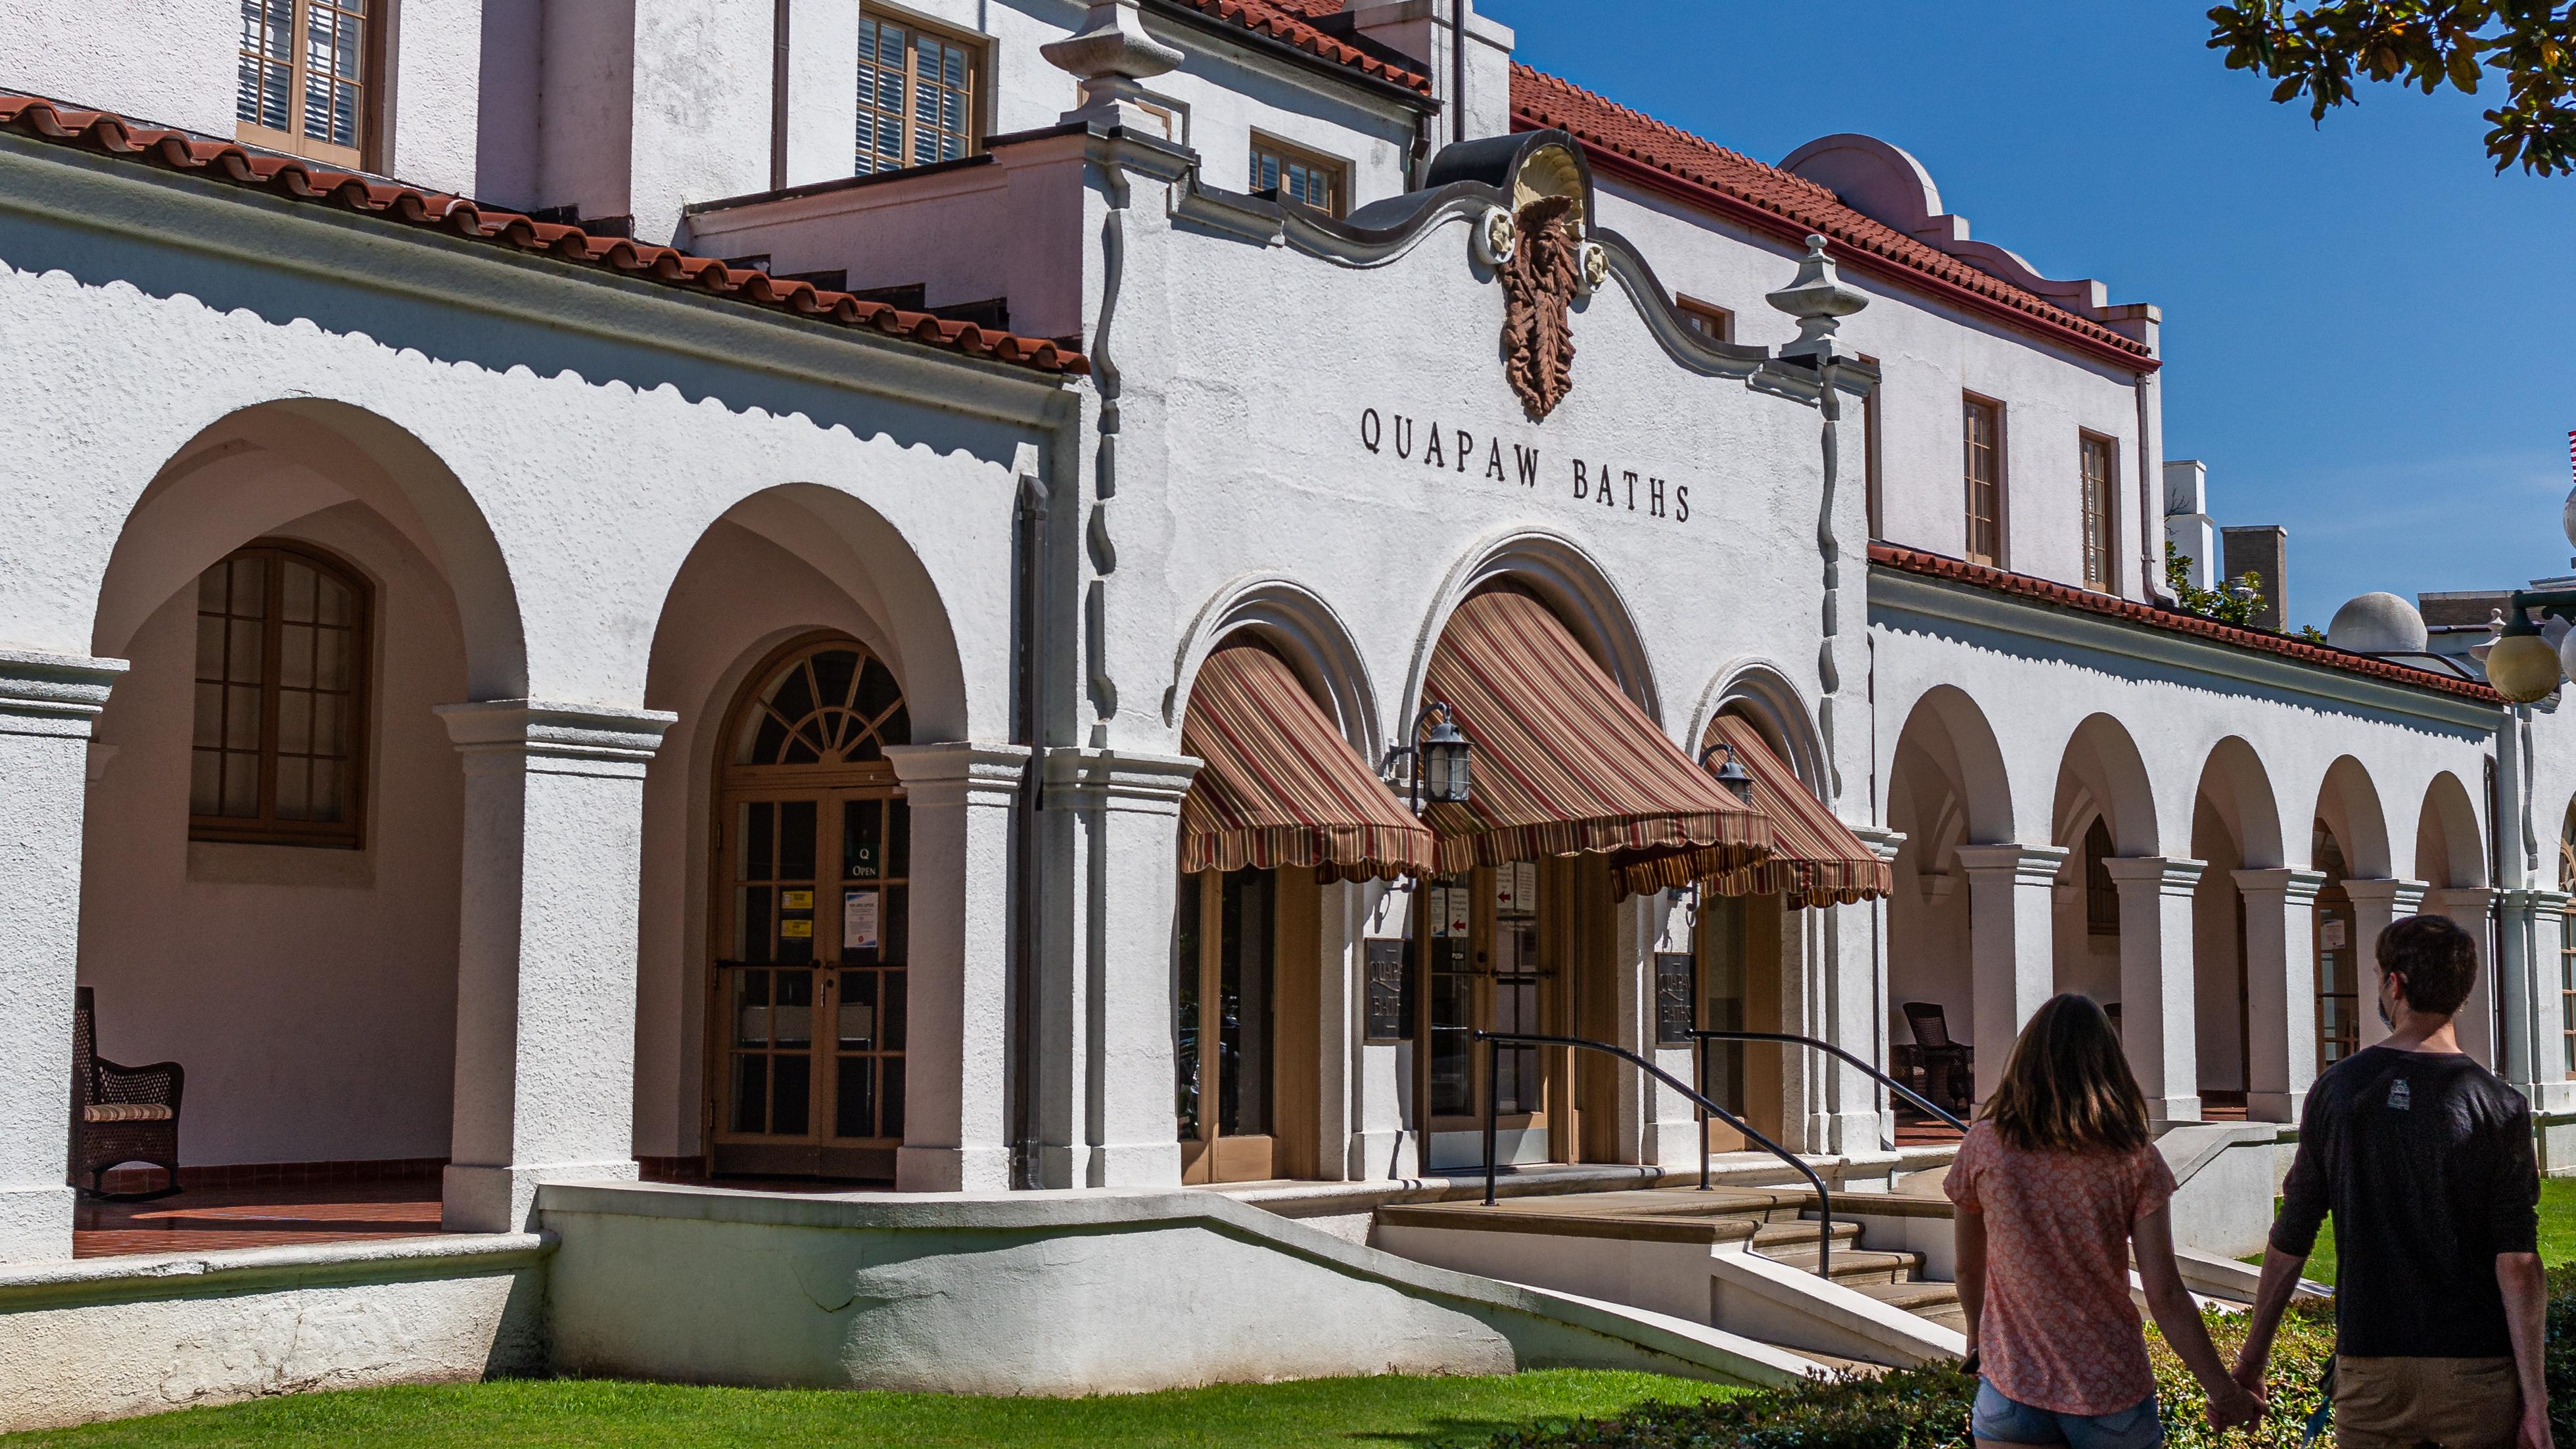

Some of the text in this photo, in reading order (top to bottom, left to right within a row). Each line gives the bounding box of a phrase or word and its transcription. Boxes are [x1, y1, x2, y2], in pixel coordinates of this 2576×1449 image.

[1361, 408, 1689, 523] QUAPAW BATHS
[860, 848, 868, 859] Q
[1370, 961, 1402, 991] QUAP
[1372, 995, 1401, 1016] BATH
[1662, 1005, 1691, 1023] BATHS
